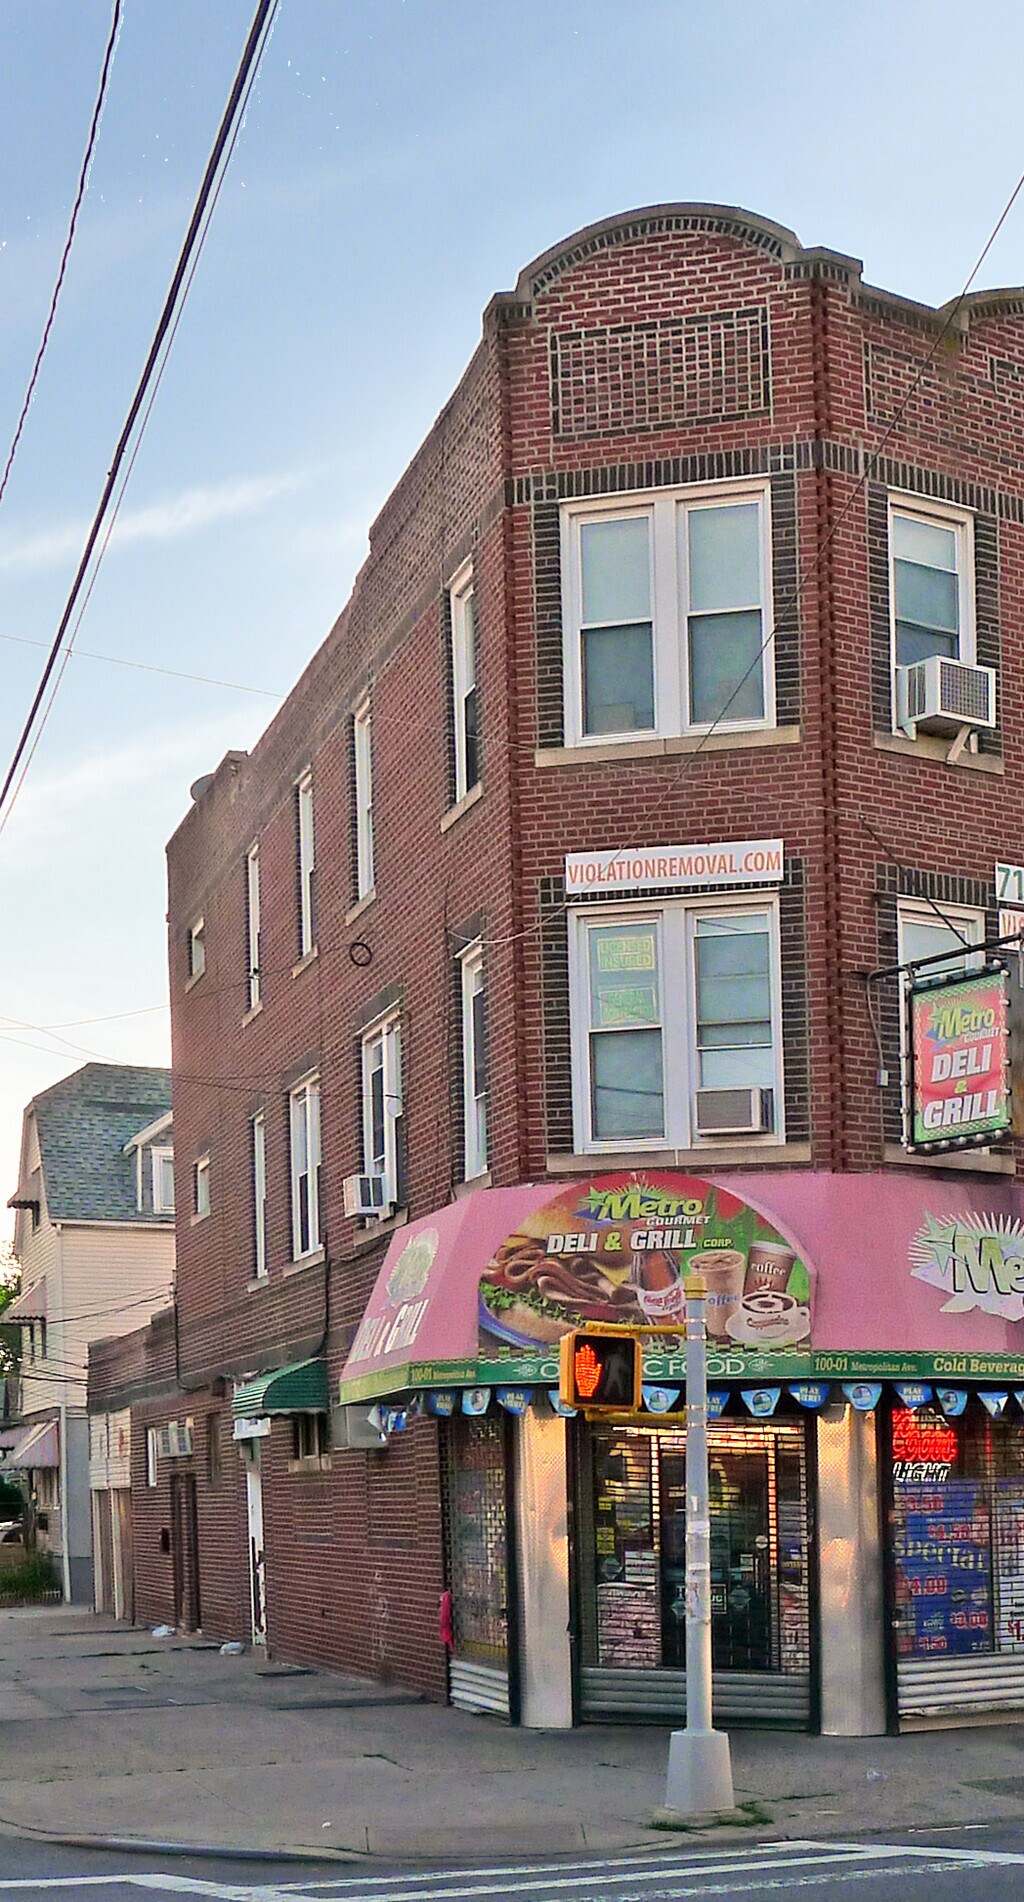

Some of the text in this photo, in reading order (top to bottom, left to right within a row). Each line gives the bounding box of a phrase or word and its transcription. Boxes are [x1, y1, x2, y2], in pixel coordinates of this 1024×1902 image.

[568, 851, 781, 884] VIOLATIONREMOVAL.COM
[938, 1008, 995, 1039] Metro
[931, 1044, 993, 1083] DELI
[954, 1079, 968, 1094] &
[923, 1089, 1000, 1129] GRILL
[599, 1193, 703, 1221] Metro
[646, 1215, 711, 1226] GOURMET
[547, 1229, 735, 1254] DELI & GRILL CORP.
[751, 1260, 786, 1276] coffee
[706, 1291, 739, 1306] offee
[385, 1299, 430, 1354] GRILL
[669, 1359, 745, 1376] FOD
[815, 1357, 848, 1371] 100-01
[851, 1362, 900, 1373] Metropolitan
[934, 1357, 966, 1372] Cold
[903, 1387, 921, 1395] PLAY
[892, 1461, 951, 1482] LIGHT
